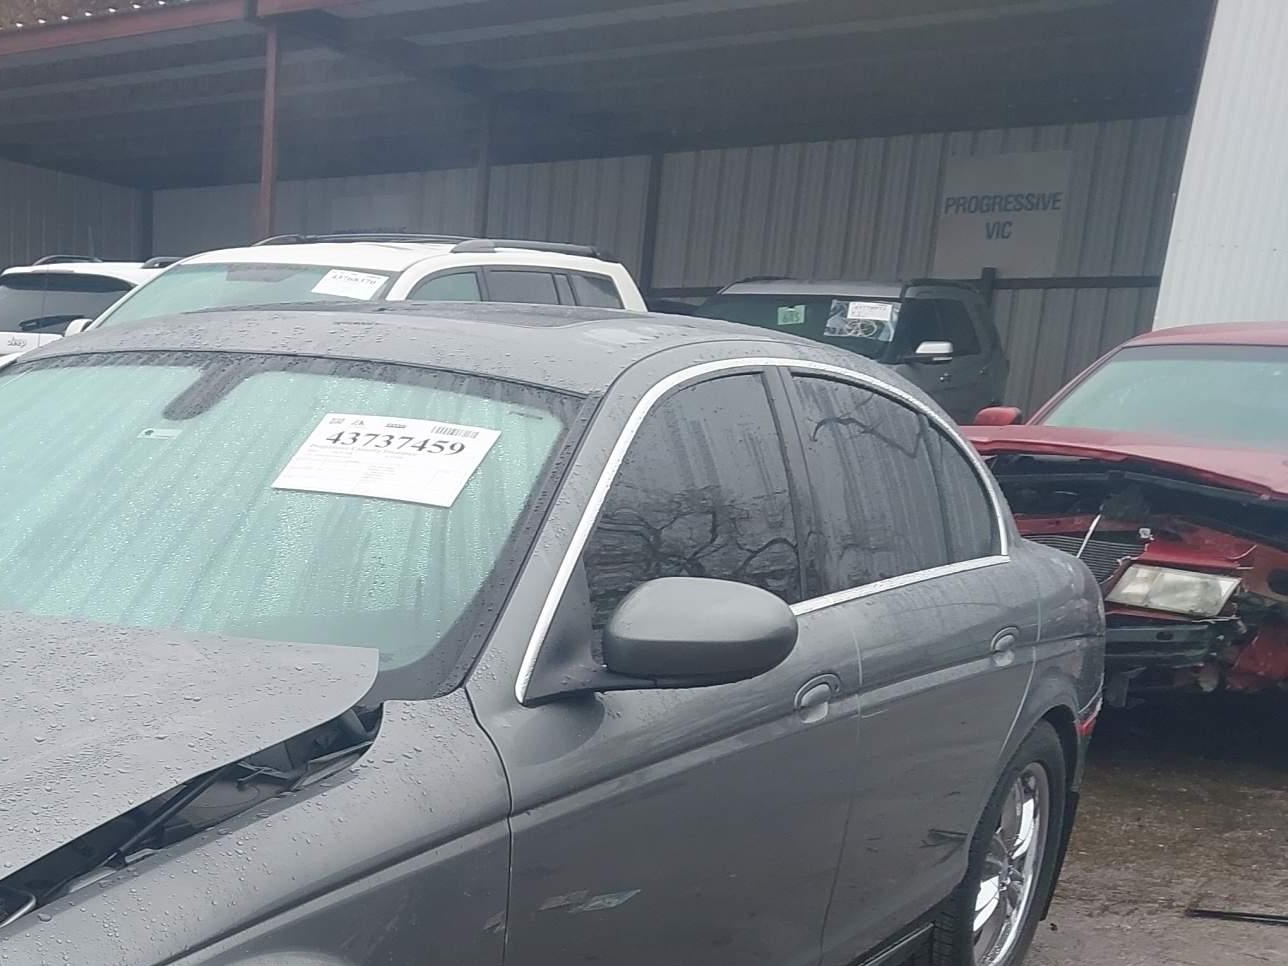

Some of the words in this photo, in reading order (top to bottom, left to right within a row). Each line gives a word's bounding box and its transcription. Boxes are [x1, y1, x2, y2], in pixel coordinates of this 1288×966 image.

[943, 192, 1063, 215] PROGRESSIVE
[984, 221, 1013, 240] VIC
[326, 430, 467, 456] 43737459
